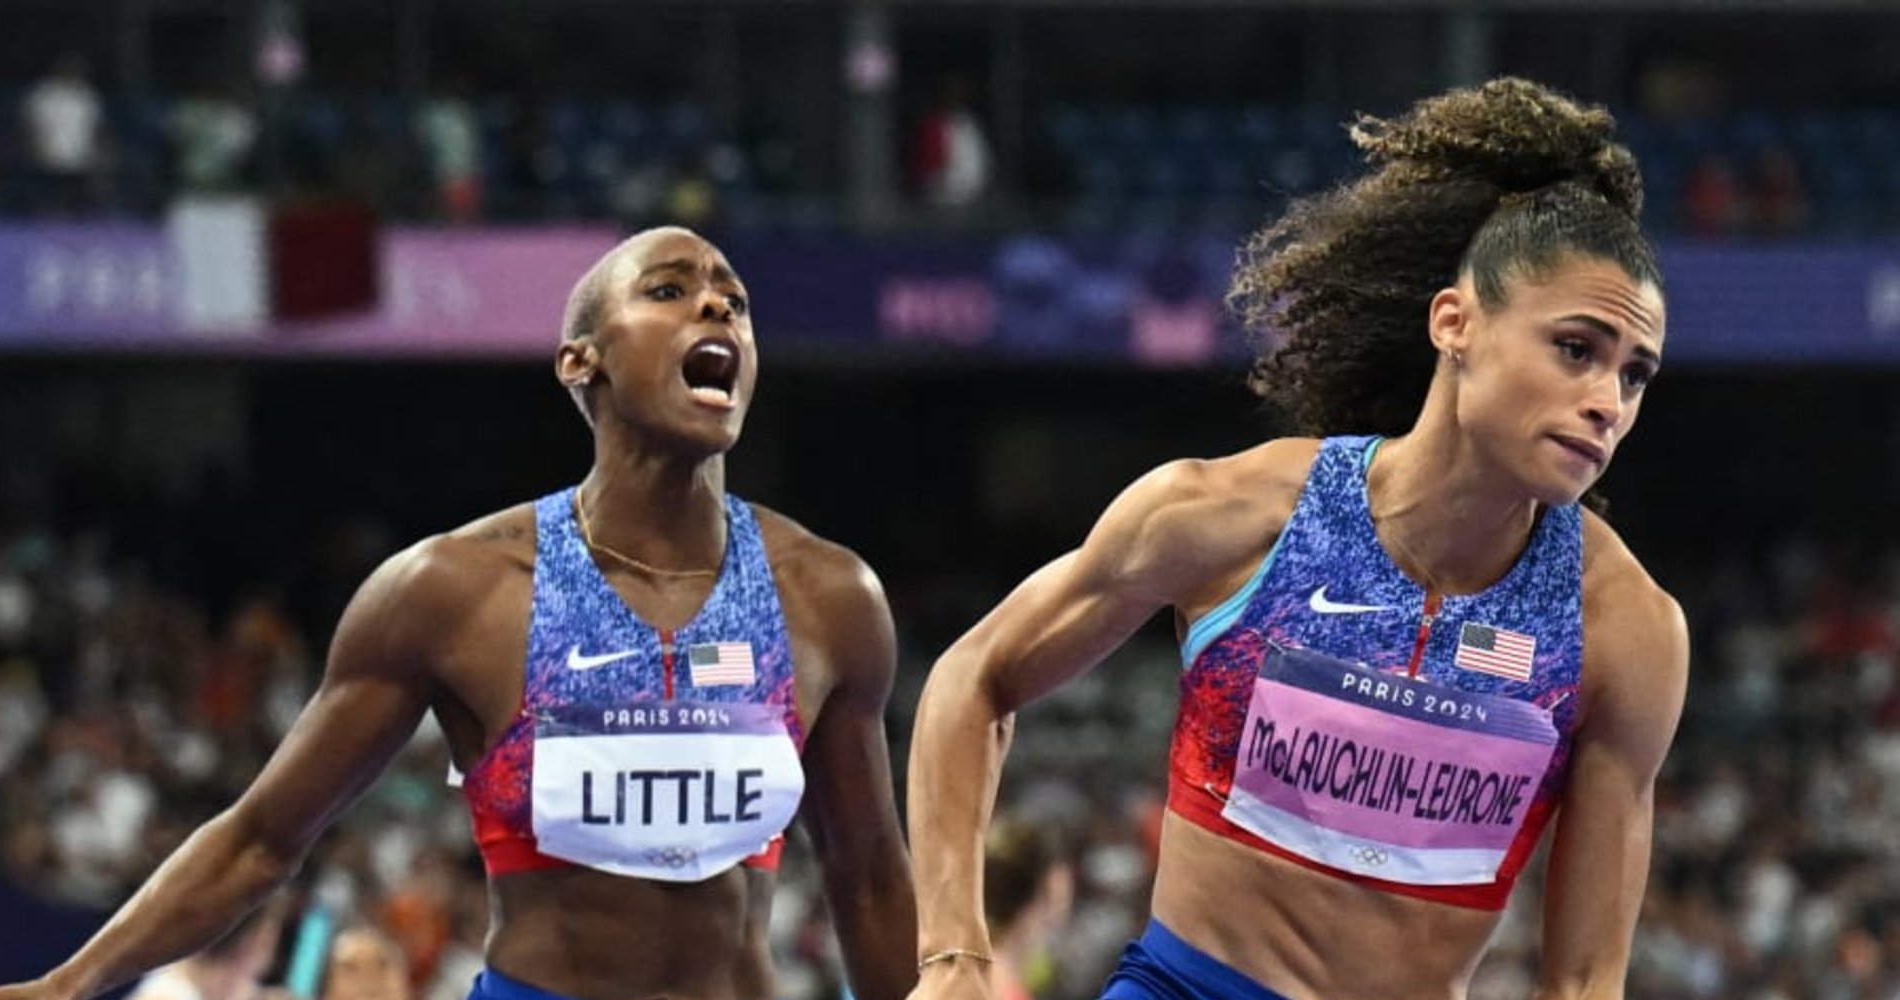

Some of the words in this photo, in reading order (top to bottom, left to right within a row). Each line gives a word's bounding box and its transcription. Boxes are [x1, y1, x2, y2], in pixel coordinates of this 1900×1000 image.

[603, 708, 671, 727] PARIS
[677, 708, 732, 726] 2024
[1342, 673, 1415, 707] PARIS
[1424, 696, 1488, 723] 2024
[582, 769, 764, 826] LITTLE
